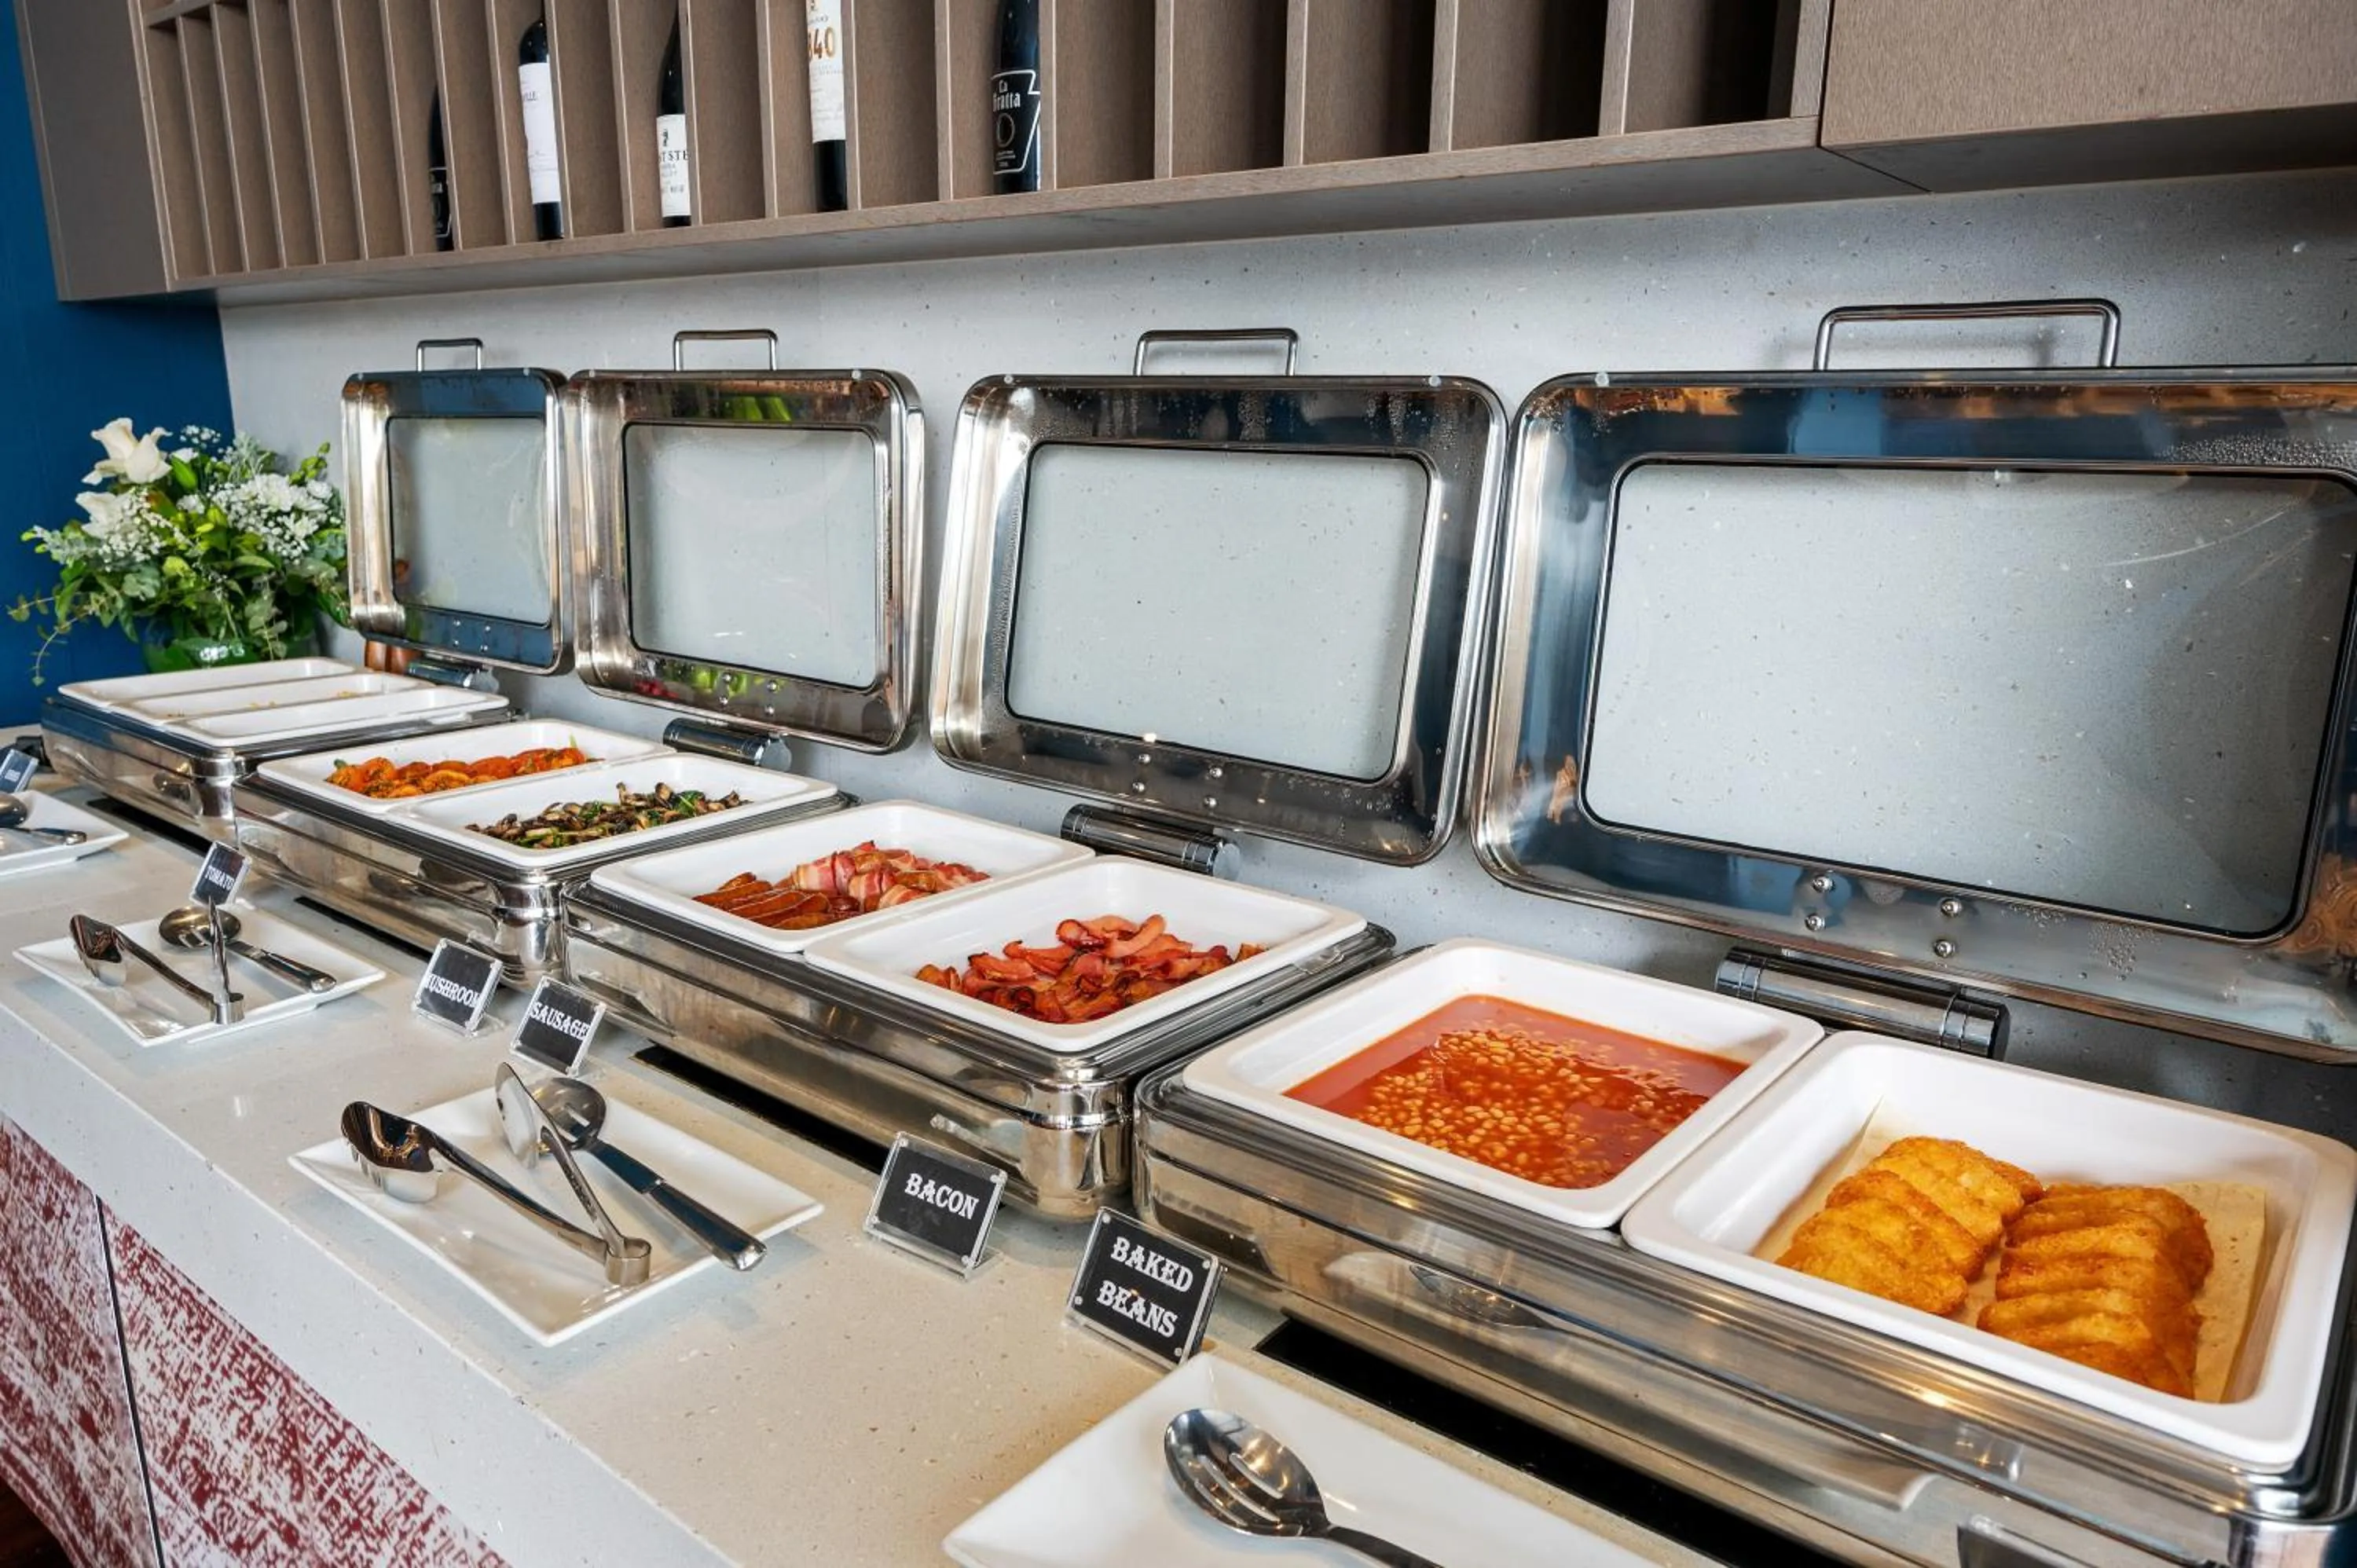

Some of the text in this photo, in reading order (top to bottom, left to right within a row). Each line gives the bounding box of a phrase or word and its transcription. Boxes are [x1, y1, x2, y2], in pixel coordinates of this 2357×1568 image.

[530, 1002, 591, 1040] SAUSAGE
[904, 1173, 980, 1221] BACON
[1110, 1236, 1193, 1293] BAKED
[1097, 1280, 1178, 1338] BEANS
